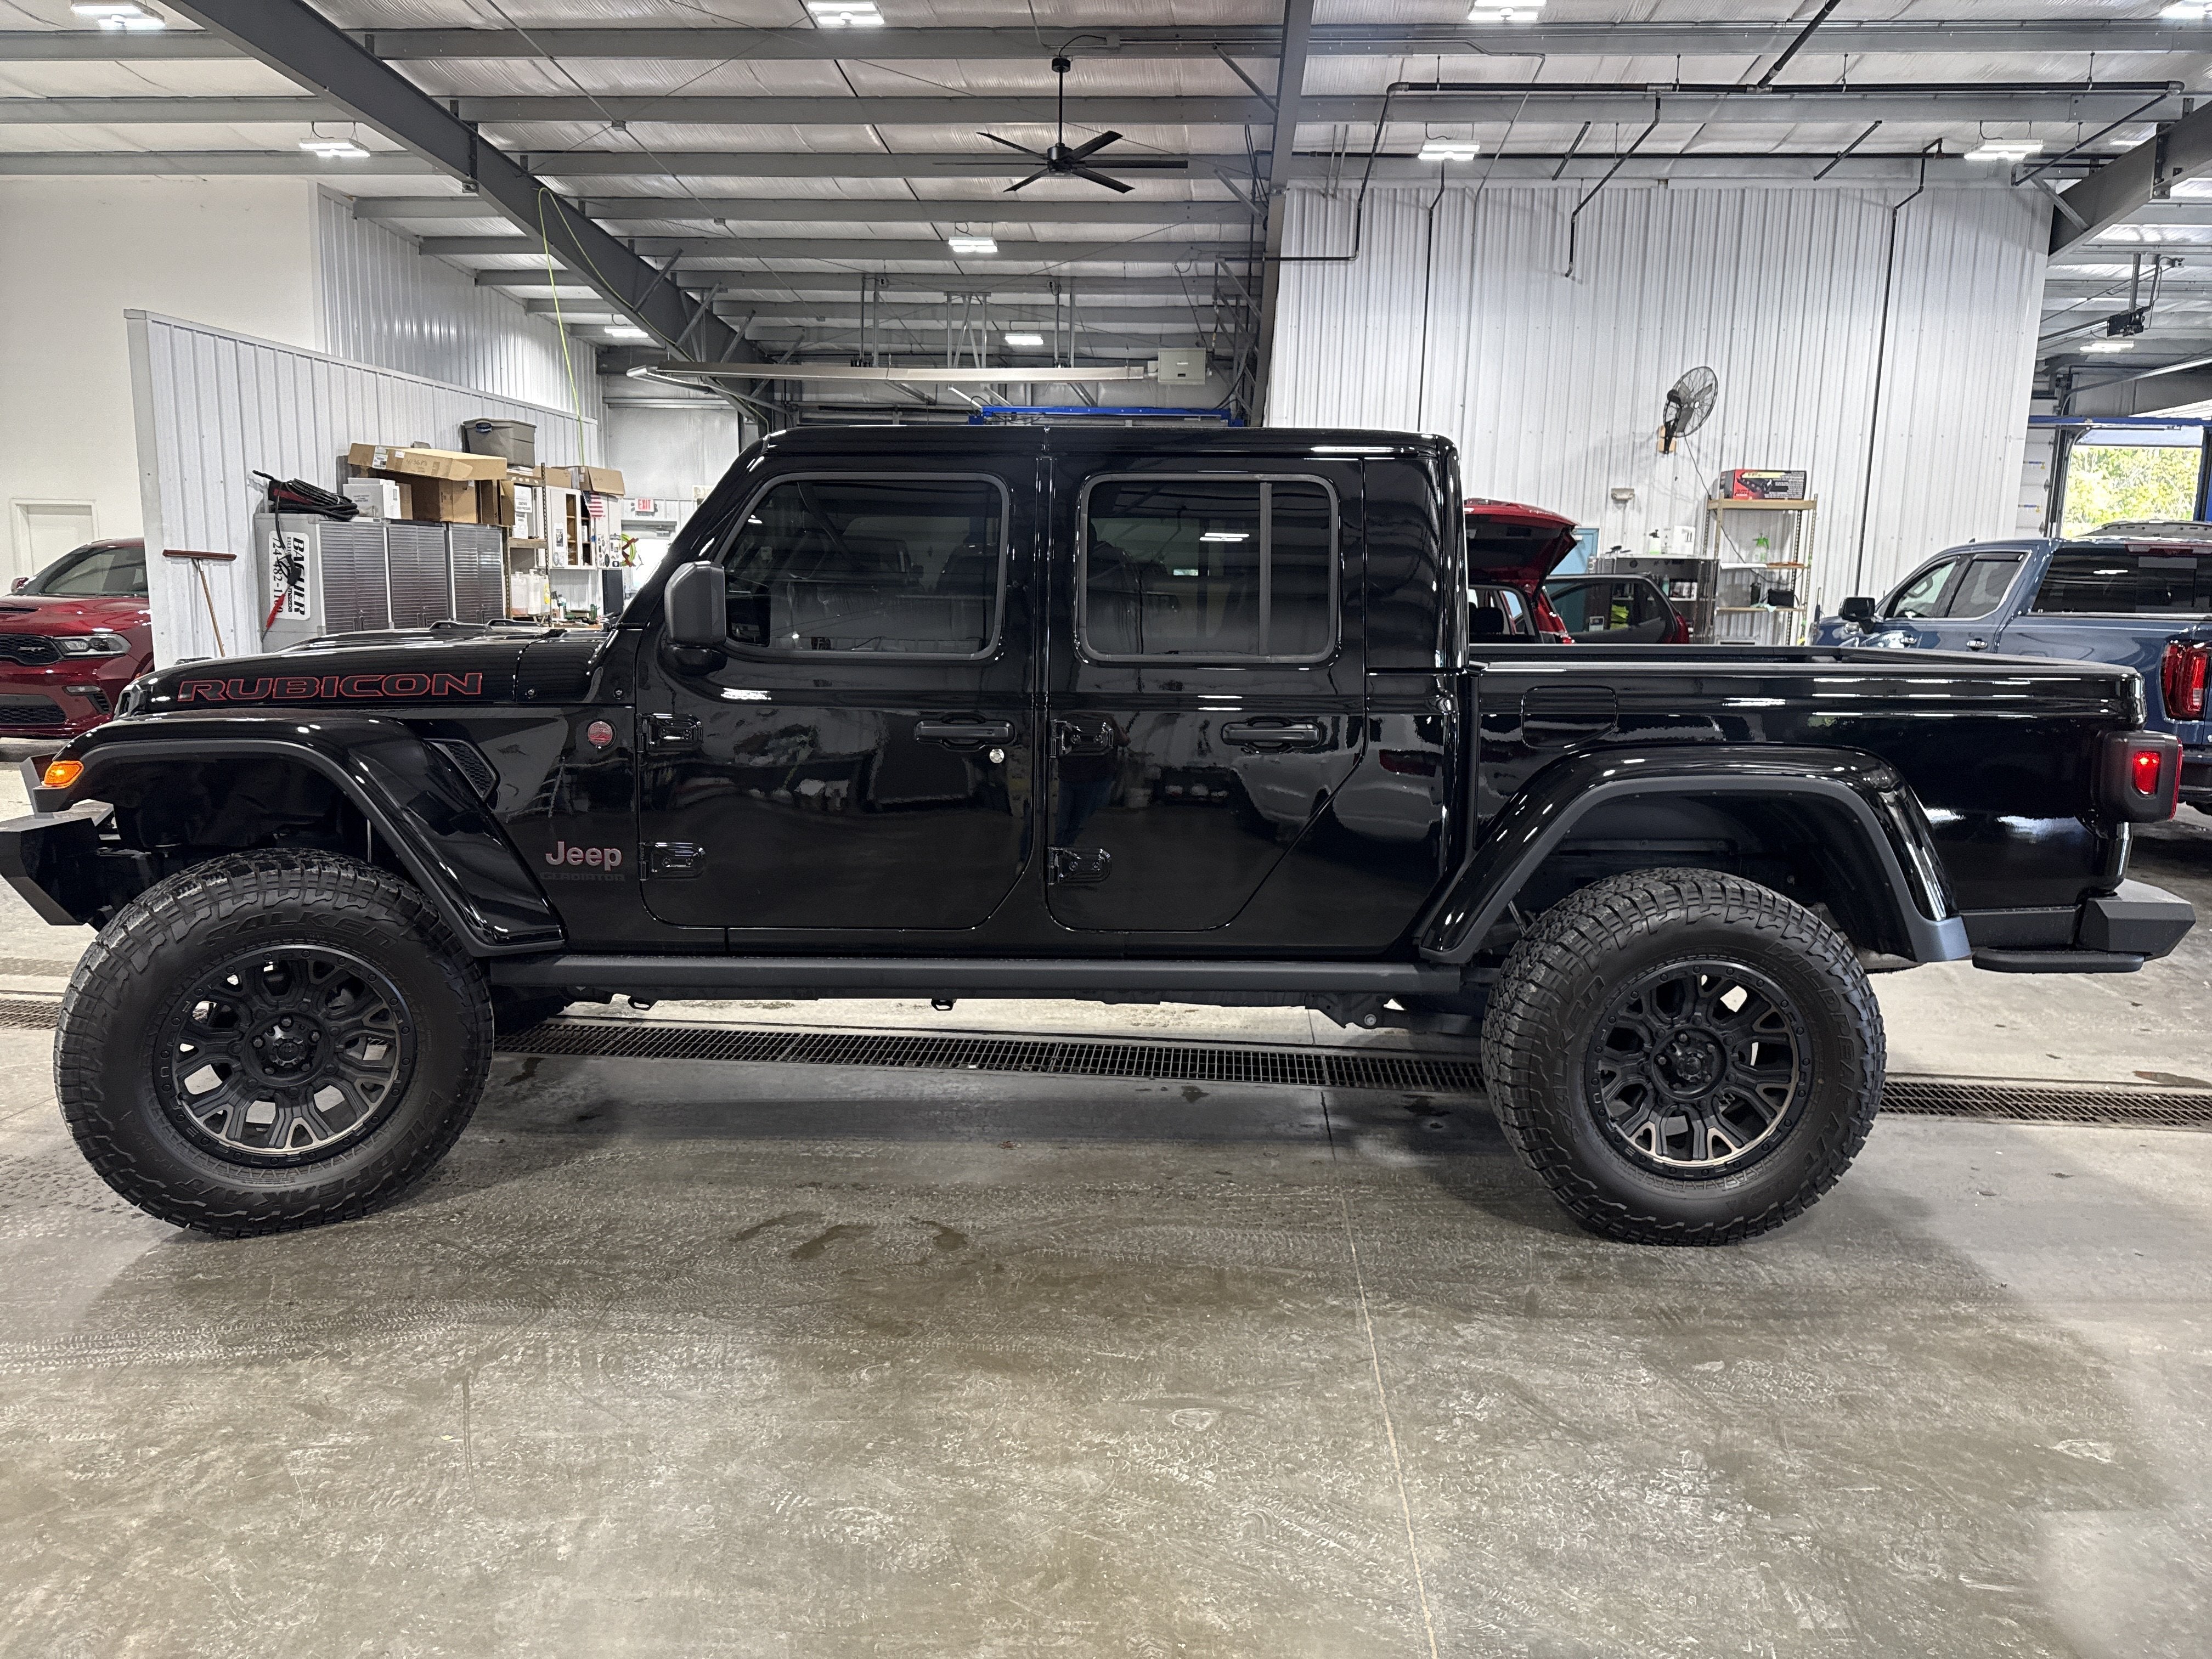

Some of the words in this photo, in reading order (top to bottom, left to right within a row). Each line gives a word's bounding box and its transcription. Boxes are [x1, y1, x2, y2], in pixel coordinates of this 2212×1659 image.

[637, 499, 651, 510] EXIT
[177, 672, 483, 702] RUBICON
[545, 840, 623, 872] Jeep
[539, 872, 625, 882] GLADIATOR
[198, 910, 399, 950] FALKEN
[1764, 941, 1855, 1114] WILDPEAK
[1553, 975, 1606, 1144] FALKEN
[253, 1090, 449, 1206] WILDPEAK
